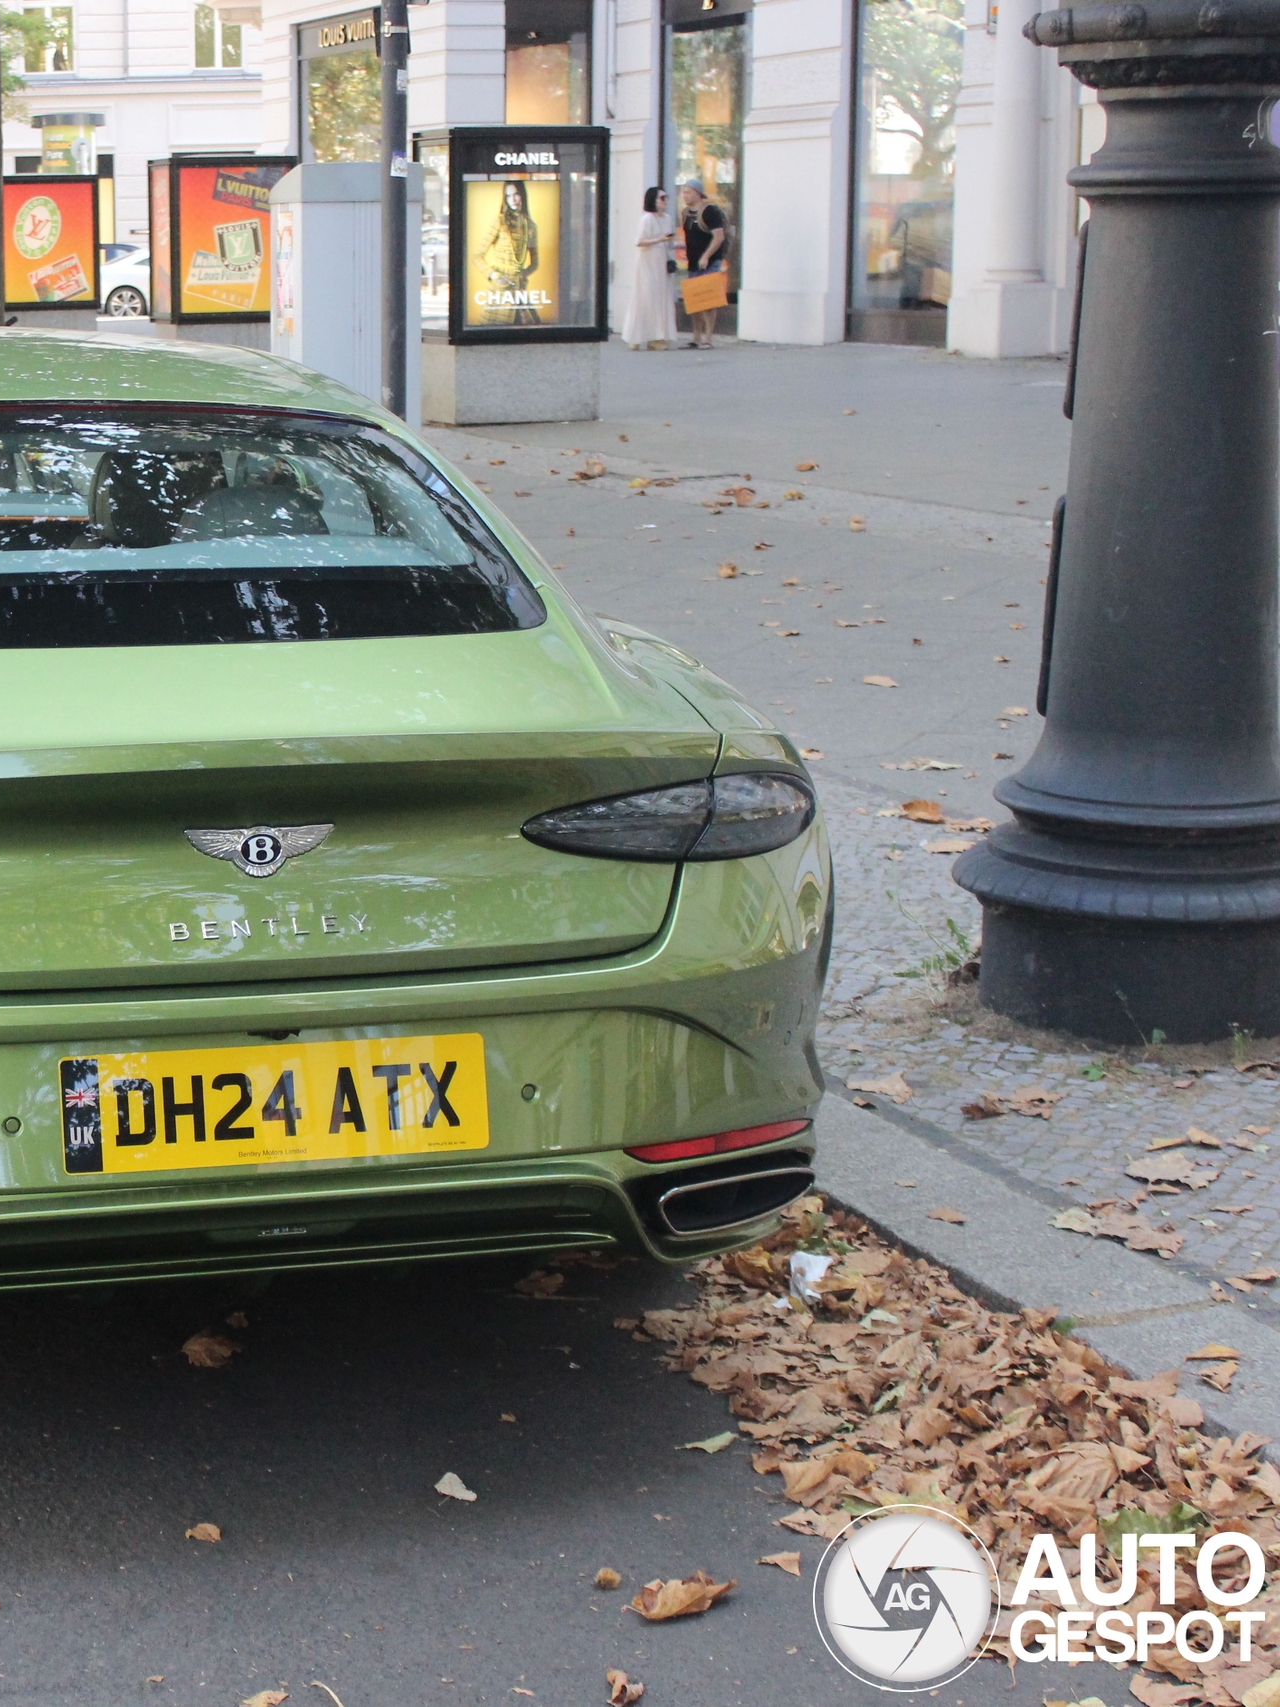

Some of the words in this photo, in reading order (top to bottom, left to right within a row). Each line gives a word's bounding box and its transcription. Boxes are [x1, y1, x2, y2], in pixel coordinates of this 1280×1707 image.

[319, 24, 346, 48] LOUIS
[347, 18, 376, 42] VUITTO
[493, 151, 560, 166] CHANEL
[221, 192, 252, 207] PARIS
[226, 180, 269, 201] VUITTO
[223, 222, 251, 233] LOUIS
[222, 253, 262, 273] VUITTON
[197, 270, 221, 281] Louis
[212, 289, 250, 306] PARIS
[474, 290, 552, 306] CHANEL
[247, 835, 275, 863] B
[169, 913, 369, 942] BENTLEY
[113, 1070, 302, 1147] DH24
[329, 1061, 461, 1135] ATX
[69, 1126, 95, 1145] UK
[238, 1150, 261, 1158] Bentley
